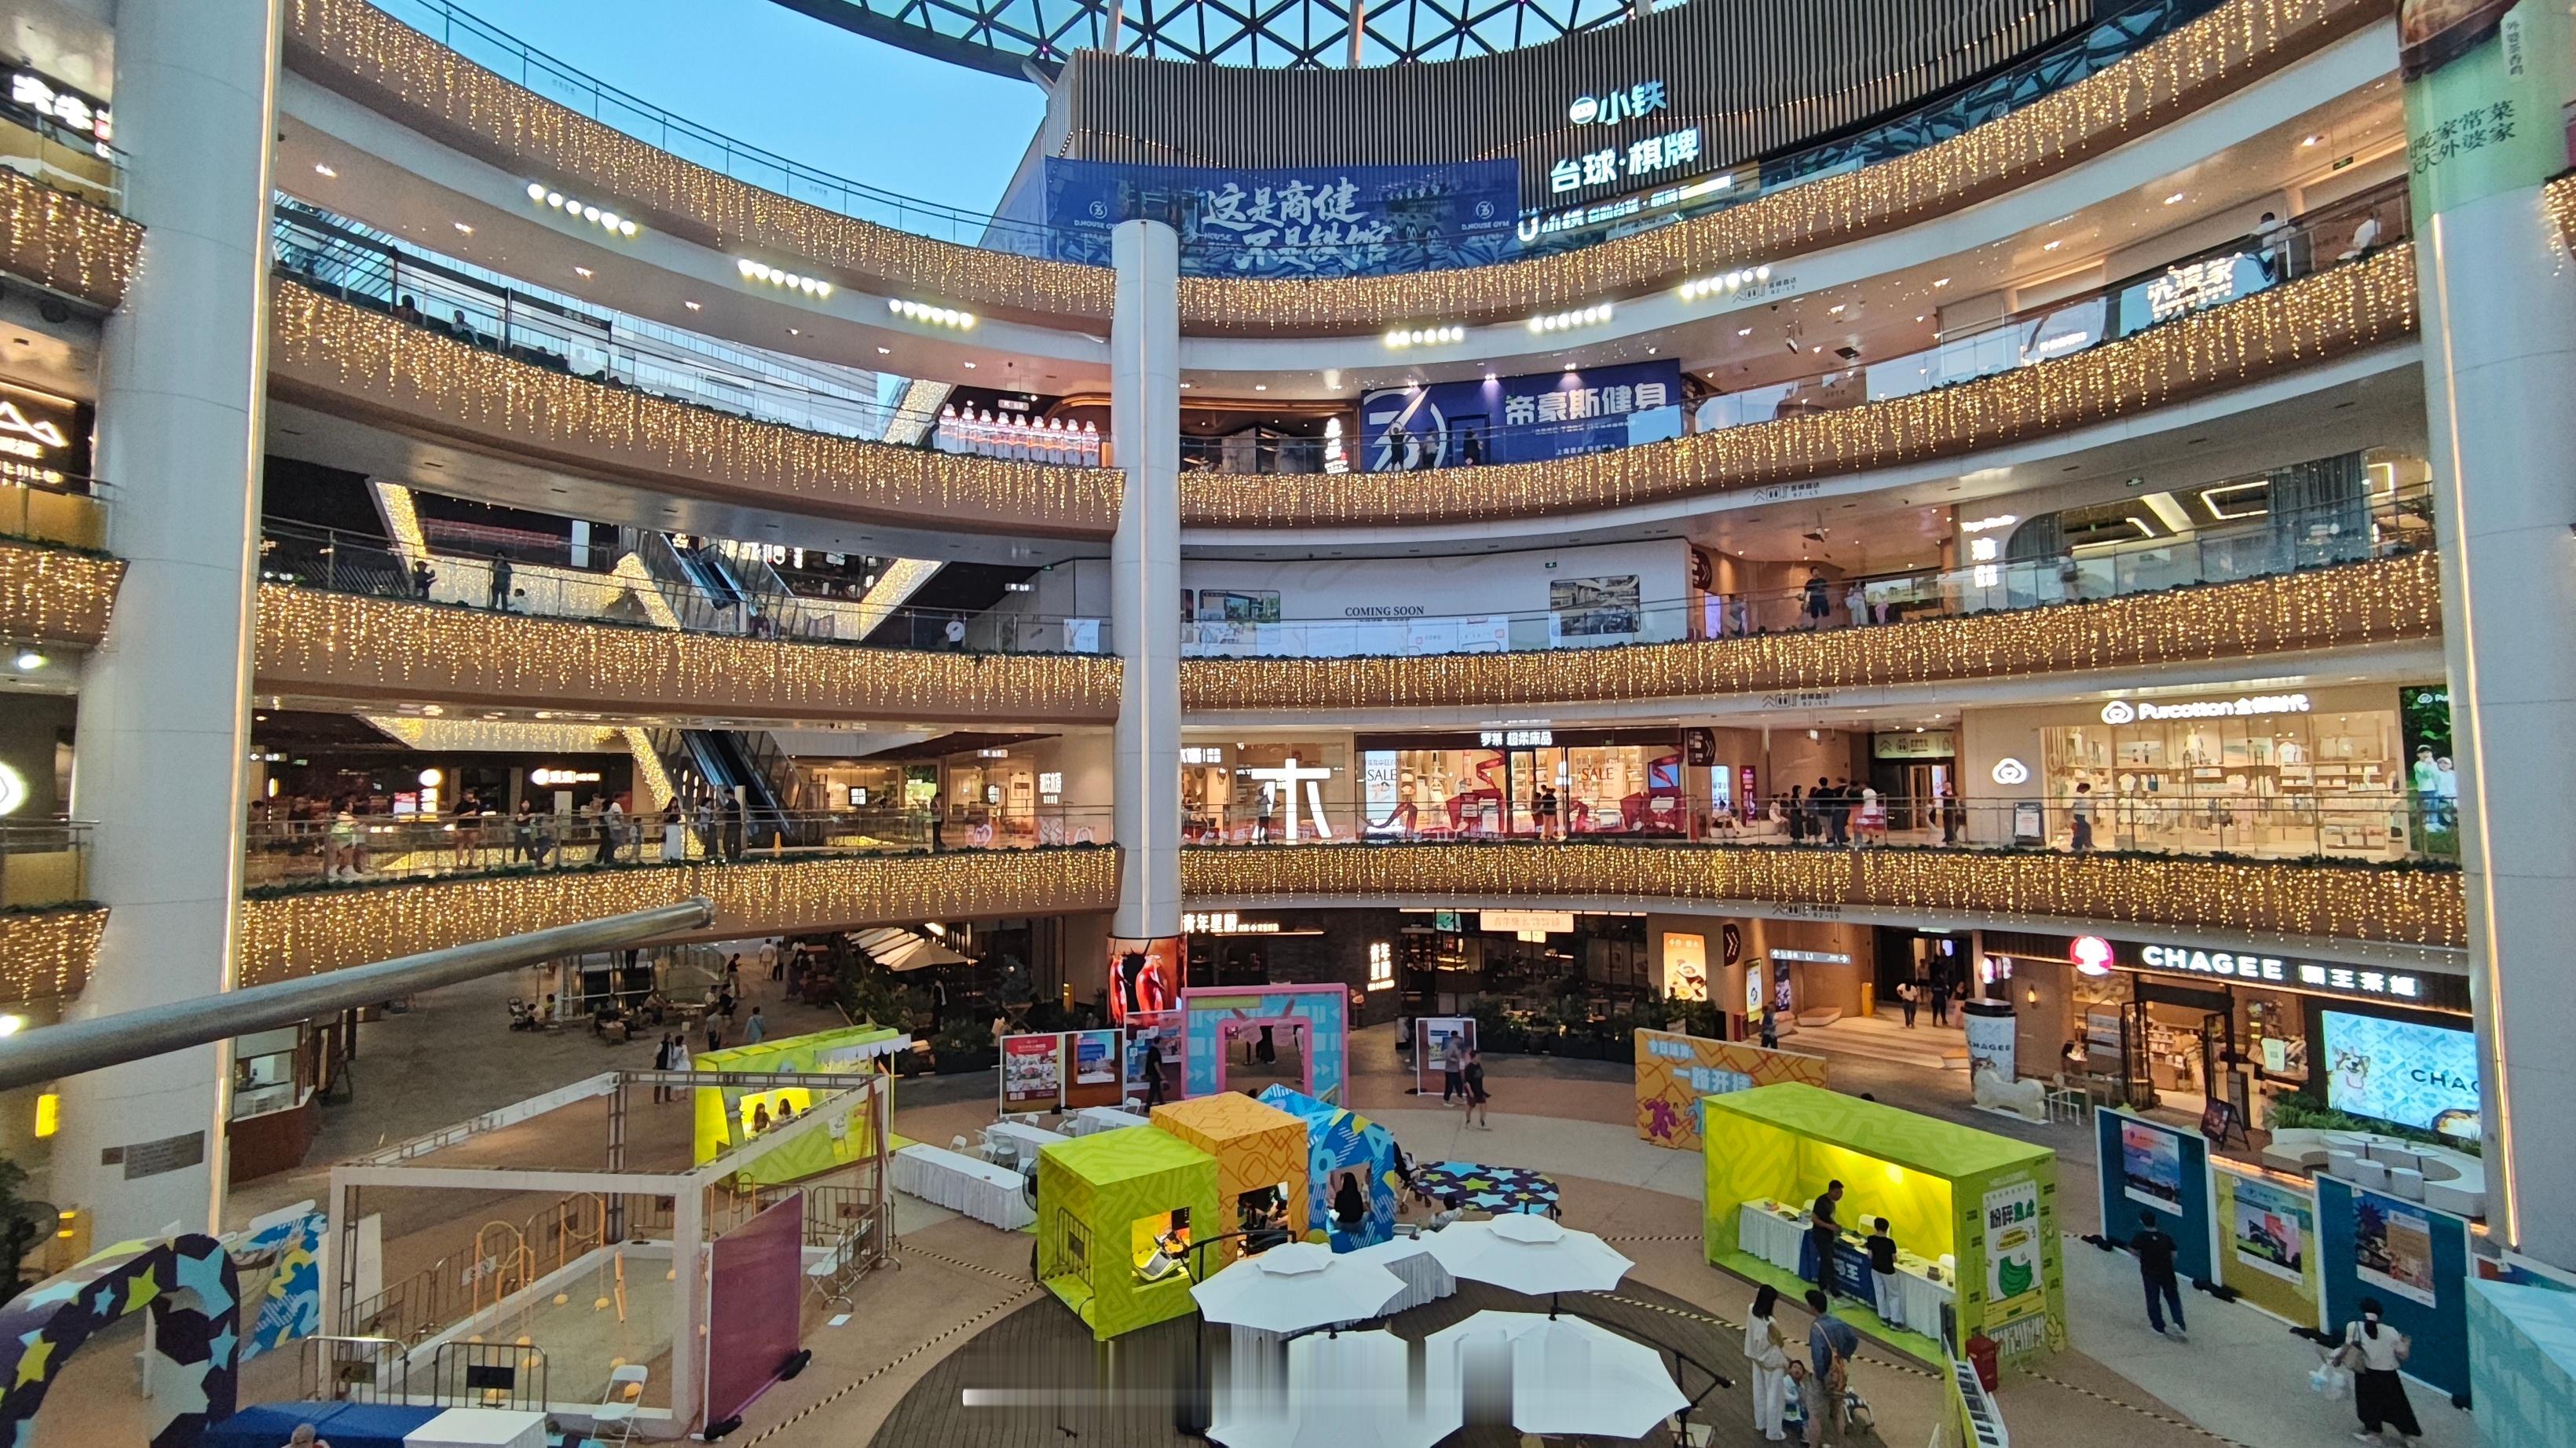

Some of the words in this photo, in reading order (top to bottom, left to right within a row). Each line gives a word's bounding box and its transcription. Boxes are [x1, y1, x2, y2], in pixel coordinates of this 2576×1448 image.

[1597, 80, 1667, 126] 小铁
[1202, 177, 1370, 229] 这是商健
[1493, 220, 1509, 229] GYM
[1505, 382, 1667, 425] 帝豪斯健身
[1345, 606, 1391, 616] COMING
[1393, 605, 1425, 616] SOON
[2138, 700, 2233, 720] Purcotton
[1367, 769, 1397, 781] SALE
[1582, 767, 1614, 781] SALE
[2142, 945, 2283, 980] CHAGEE
[2299, 964, 2417, 996] 霸王茶姬
